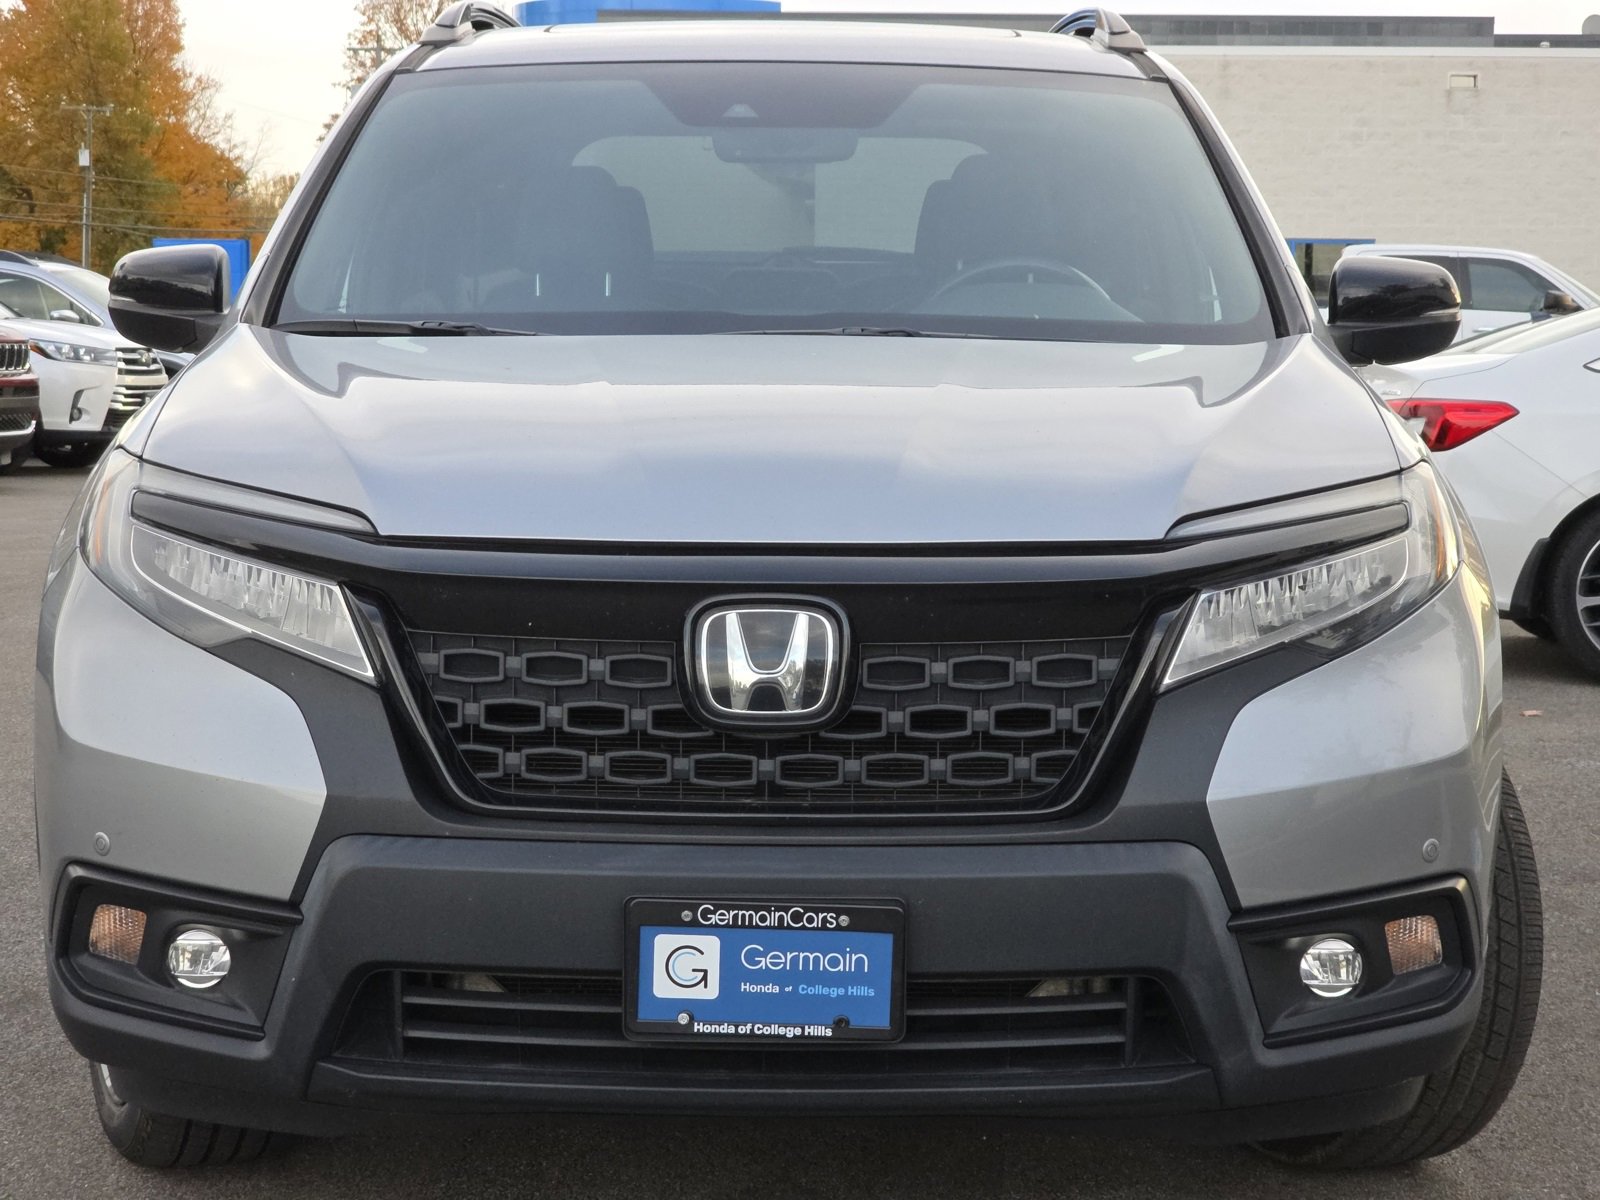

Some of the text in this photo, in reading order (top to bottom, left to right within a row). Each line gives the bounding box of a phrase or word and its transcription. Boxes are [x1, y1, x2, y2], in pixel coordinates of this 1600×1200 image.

[697, 904, 836, 929] GermainCars
[741, 944, 868, 973] Germain
[741, 982, 779, 994] Honda
[798, 984, 845, 997] College
[848, 986, 875, 997] Hills
[694, 1022, 832, 1038] Honda of College Hills
